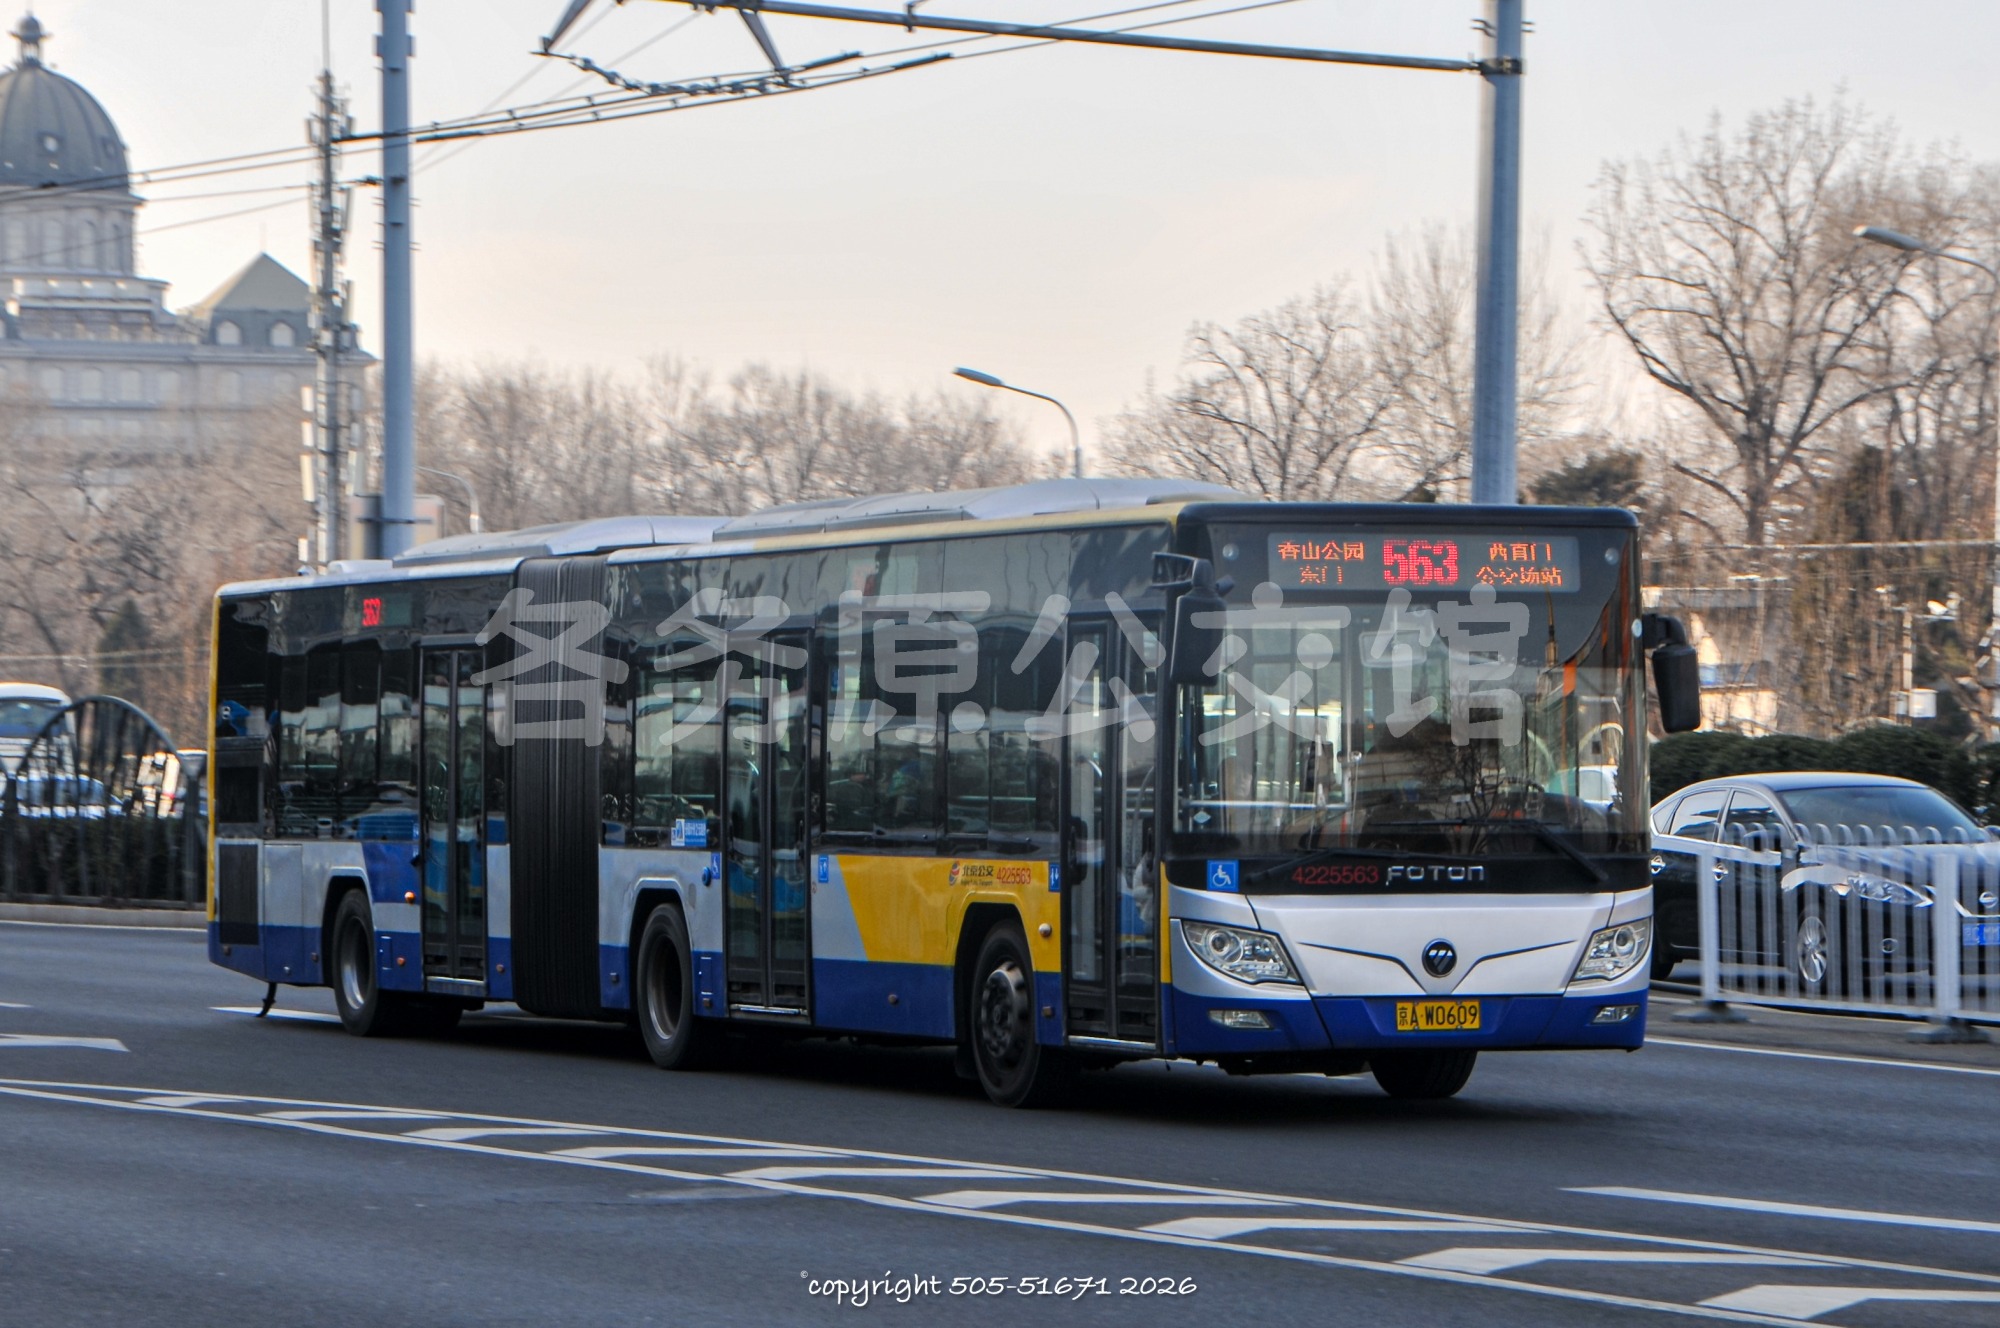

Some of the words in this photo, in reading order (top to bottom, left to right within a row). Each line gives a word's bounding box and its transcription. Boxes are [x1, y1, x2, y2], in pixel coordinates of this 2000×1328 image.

[1278, 541, 1365, 562] 香山公园
[1383, 539, 1459, 586] 563
[1476, 566, 1562, 587] 公交场站
[962, 865, 994, 878] 北京公交
[996, 867, 1032, 885] 4225563
[1291, 865, 1380, 885] 4225563
[1385, 865, 1485, 886] FOTON
